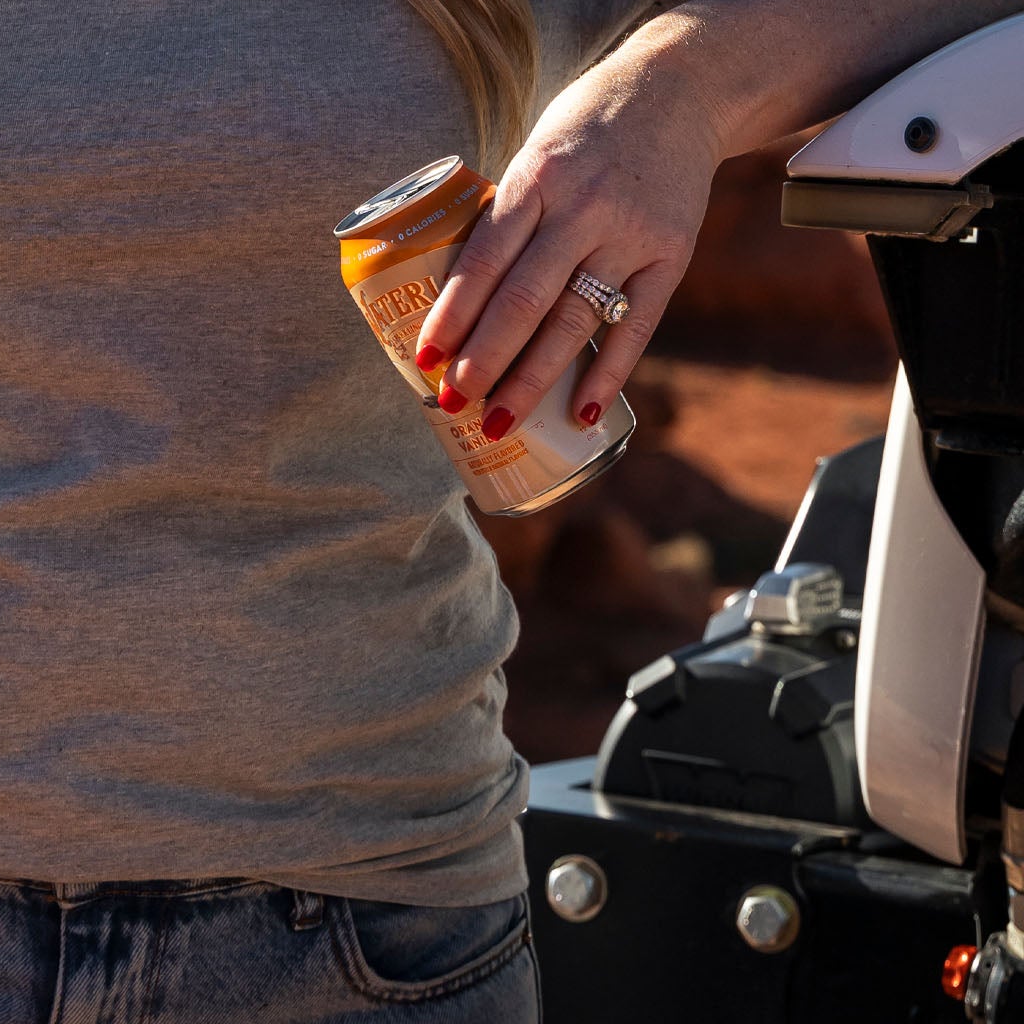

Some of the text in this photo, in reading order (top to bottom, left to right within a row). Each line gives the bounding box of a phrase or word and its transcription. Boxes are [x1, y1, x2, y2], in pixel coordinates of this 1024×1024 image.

[363, 242, 388, 259] SUGAR
[398, 232, 405, 241] 0
[406, 208, 448, 237] CALORIES
[450, 417, 483, 439] ORAN
[493, 439, 525, 461] FLAVORED
